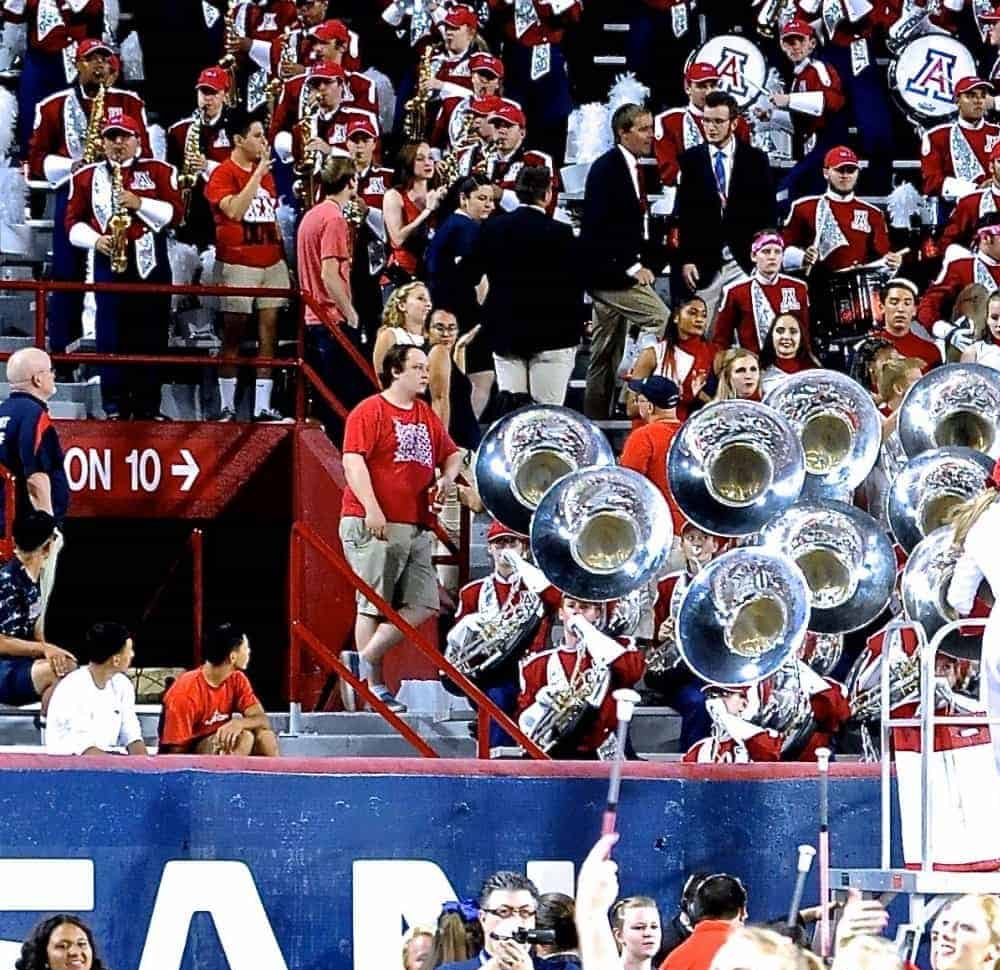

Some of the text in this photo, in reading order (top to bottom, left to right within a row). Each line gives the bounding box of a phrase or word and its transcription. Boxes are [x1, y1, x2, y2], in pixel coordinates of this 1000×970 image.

[717, 47, 748, 97] A
[906, 48, 957, 103] A
[63, 447, 161, 492] ON 10
